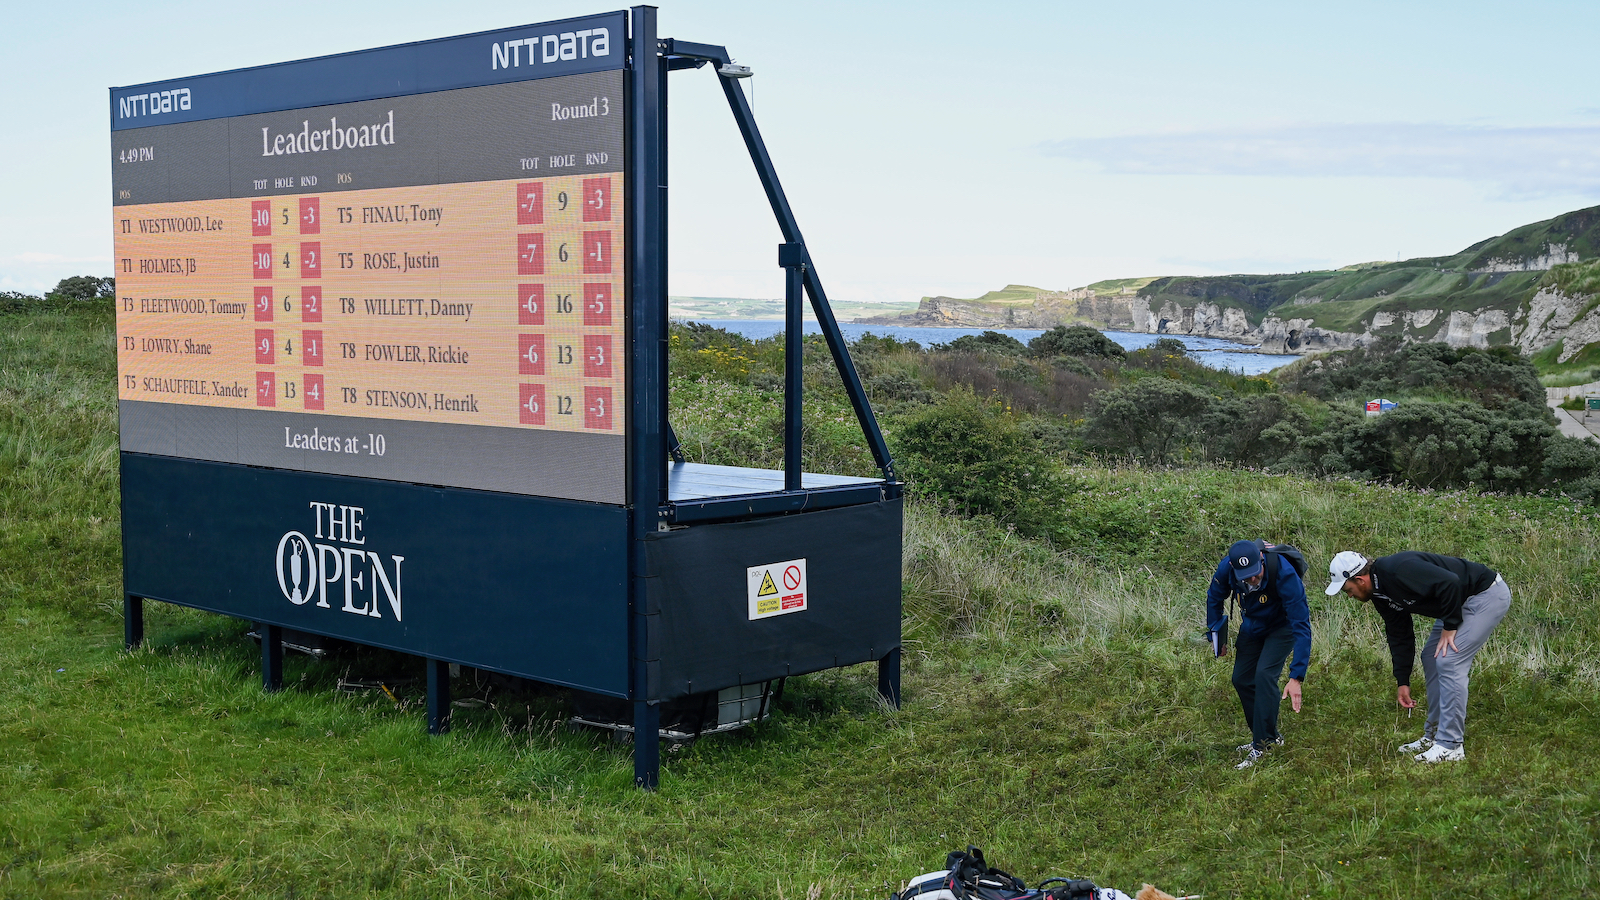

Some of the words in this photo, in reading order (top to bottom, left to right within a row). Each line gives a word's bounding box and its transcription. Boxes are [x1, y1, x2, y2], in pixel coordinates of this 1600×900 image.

[492, 37, 539, 70] NTT
[120, 94, 148, 119] NTT
[551, 96, 598, 121] Round
[601, 96, 610, 116] 3
[262, 110, 395, 157] Leaderboard
[120, 148, 138, 164] 4.49
[140, 146, 154, 161] PM
[520, 157, 540, 170] TOT
[550, 154, 576, 168] HOLE
[586, 152, 608, 166] RND
[254, 179, 268, 190] TOT
[274, 177, 294, 188] HOLE
[300, 176, 318, 187] RND
[337, 173, 352, 184] POS
[120, 190, 130, 200] POS
[120, 219, 131, 233] T1
[139, 217, 204, 234] WESTWOOD,
[206, 216, 223, 231] Lee
[253, 209, 269, 226] -10
[282, 208, 289, 225] 5
[304, 207, 314, 224] -3
[337, 207, 352, 223] T5
[362, 205, 409, 225] FINAU,
[410, 204, 443, 227] Tony
[522, 193, 536, 213] -7
[558, 191, 568, 210] 9
[589, 189, 603, 209] -3
[122, 259, 132, 272] T1
[140, 259, 184, 274] HOLMES,
[186, 259, 196, 276] JB
[254, 253, 270, 269] -10
[283, 252, 290, 268] 4
[304, 251, 316, 268] -2
[338, 252, 353, 268] T5
[364, 253, 400, 271] ROSE,
[403, 251, 440, 272] Justin
[522, 243, 536, 263] -7
[559, 243, 568, 262] 6
[589, 242, 603, 261] -1
[122, 298, 134, 312] T3
[141, 298, 208, 316] FLEETWOOD,
[209, 300, 247, 320] Tommy
[257, 296, 268, 312] -9
[284, 295, 291, 312] 6
[306, 296, 317, 312] -2
[339, 298, 355, 314] T8
[365, 299, 428, 319] WILLETT,
[431, 299, 473, 322] Danny
[522, 294, 537, 314] -6
[556, 294, 572, 314] 16
[589, 294, 604, 313] -5
[124, 337, 135, 351] T3
[142, 338, 182, 354] LOWRY,
[185, 339, 212, 355] Shane
[258, 338, 269, 354] -9
[285, 339, 292, 355] 4
[307, 340, 316, 356] -1
[340, 343, 356, 359] T8
[365, 344, 426, 365] FOWLER,
[428, 346, 468, 364] Rickie
[523, 344, 538, 364] -6
[558, 345, 573, 364] 13
[590, 346, 604, 366] -3
[125, 375, 136, 389] T5
[143, 377, 210, 398] SCHAUFFELE,
[212, 380, 248, 398] Xander
[259, 381, 270, 397] -7
[284, 382, 295, 398] 13
[307, 383, 319, 400] -4
[341, 387, 357, 404] T8
[366, 389, 432, 412] STENSON,
[434, 393, 479, 413] Henrik
[524, 394, 539, 413] -6
[557, 396, 573, 415] 12
[590, 397, 604, 417] -3
[285, 426, 341, 452] Leaders
[345, 436, 359, 454] at
[362, 434, 386, 456] -10
[309, 501, 366, 545] THE
[276, 530, 404, 622] OPEN
